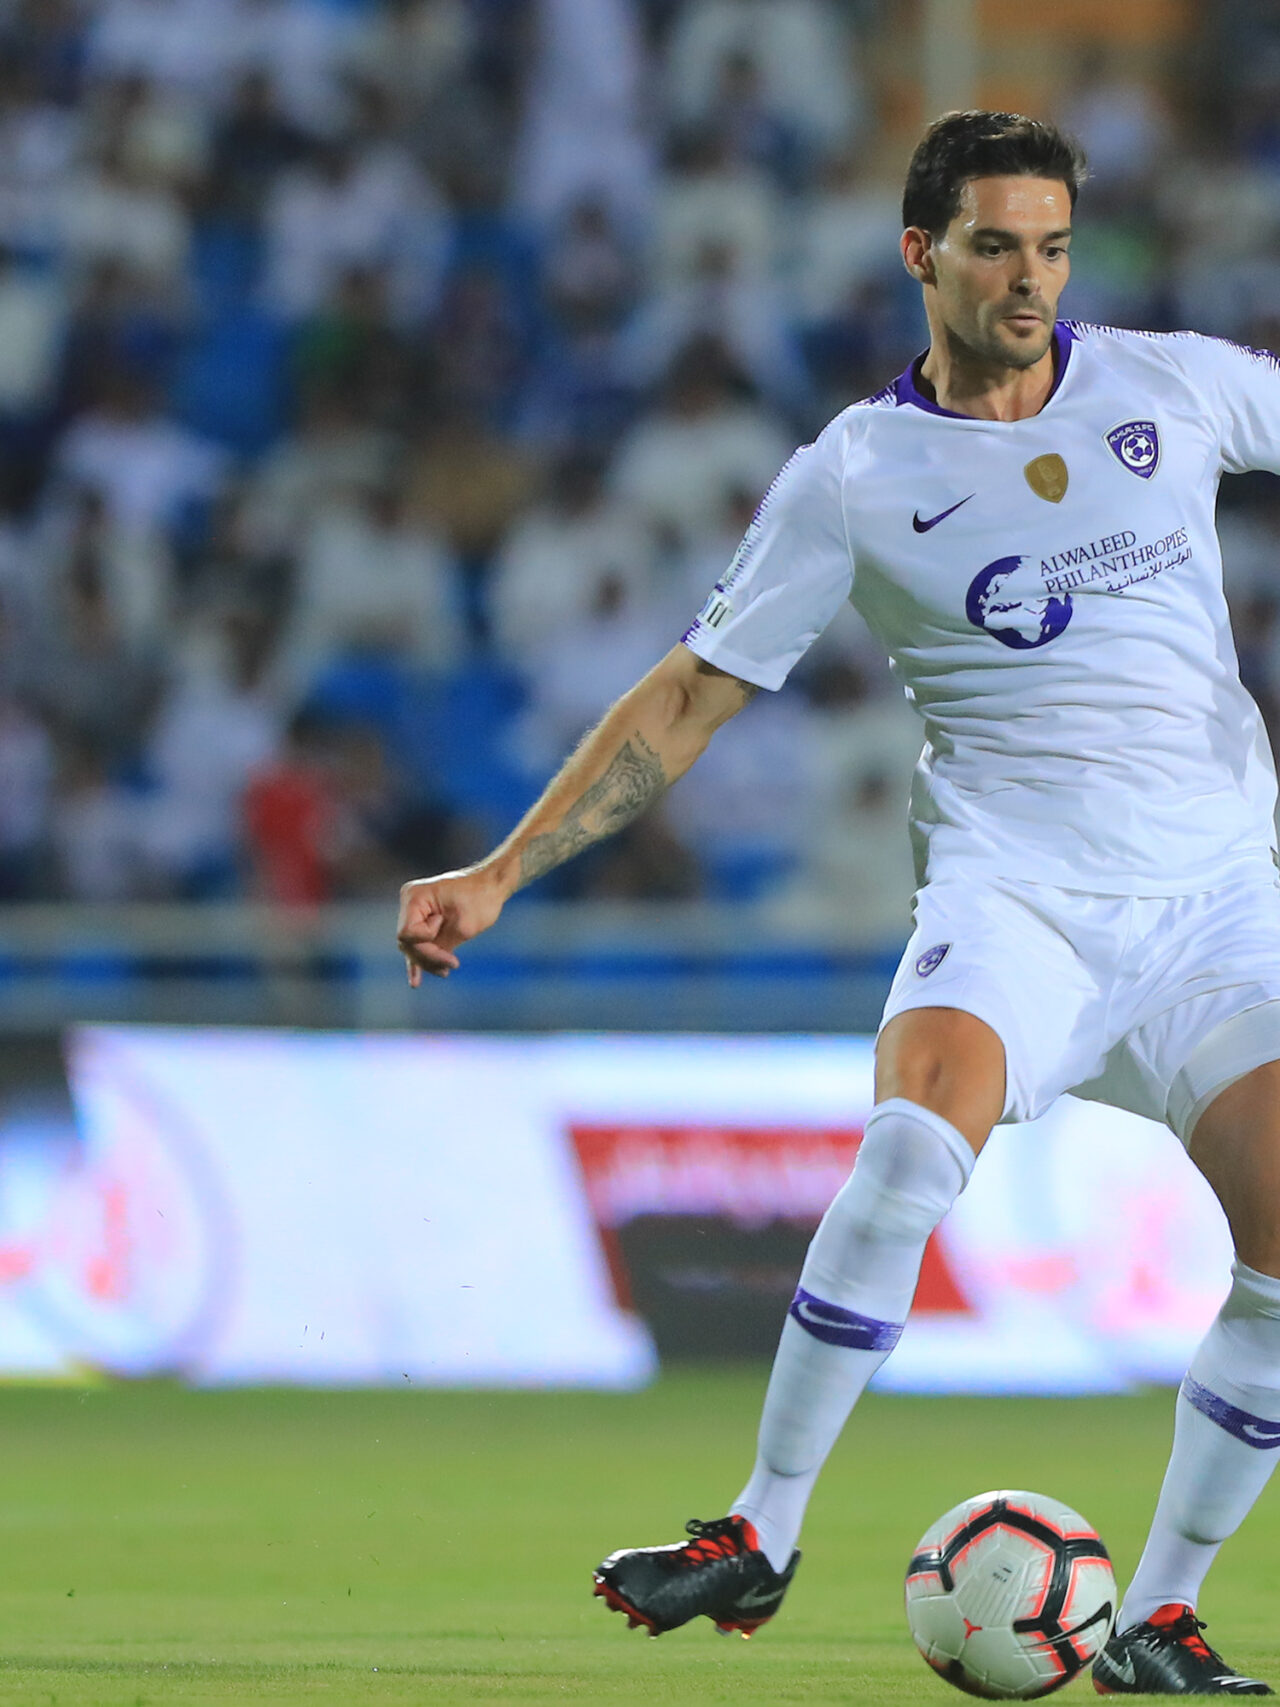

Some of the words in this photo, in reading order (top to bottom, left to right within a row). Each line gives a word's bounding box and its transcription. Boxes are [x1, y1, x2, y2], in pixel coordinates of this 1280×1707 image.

[1040, 530, 1137, 577] ALWALEED
[1044, 526, 1189, 593] PHILANTHROPIES
[1164, 546, 1193, 570] الوليد
[1106, 560, 1163, 594] للإنسانية
